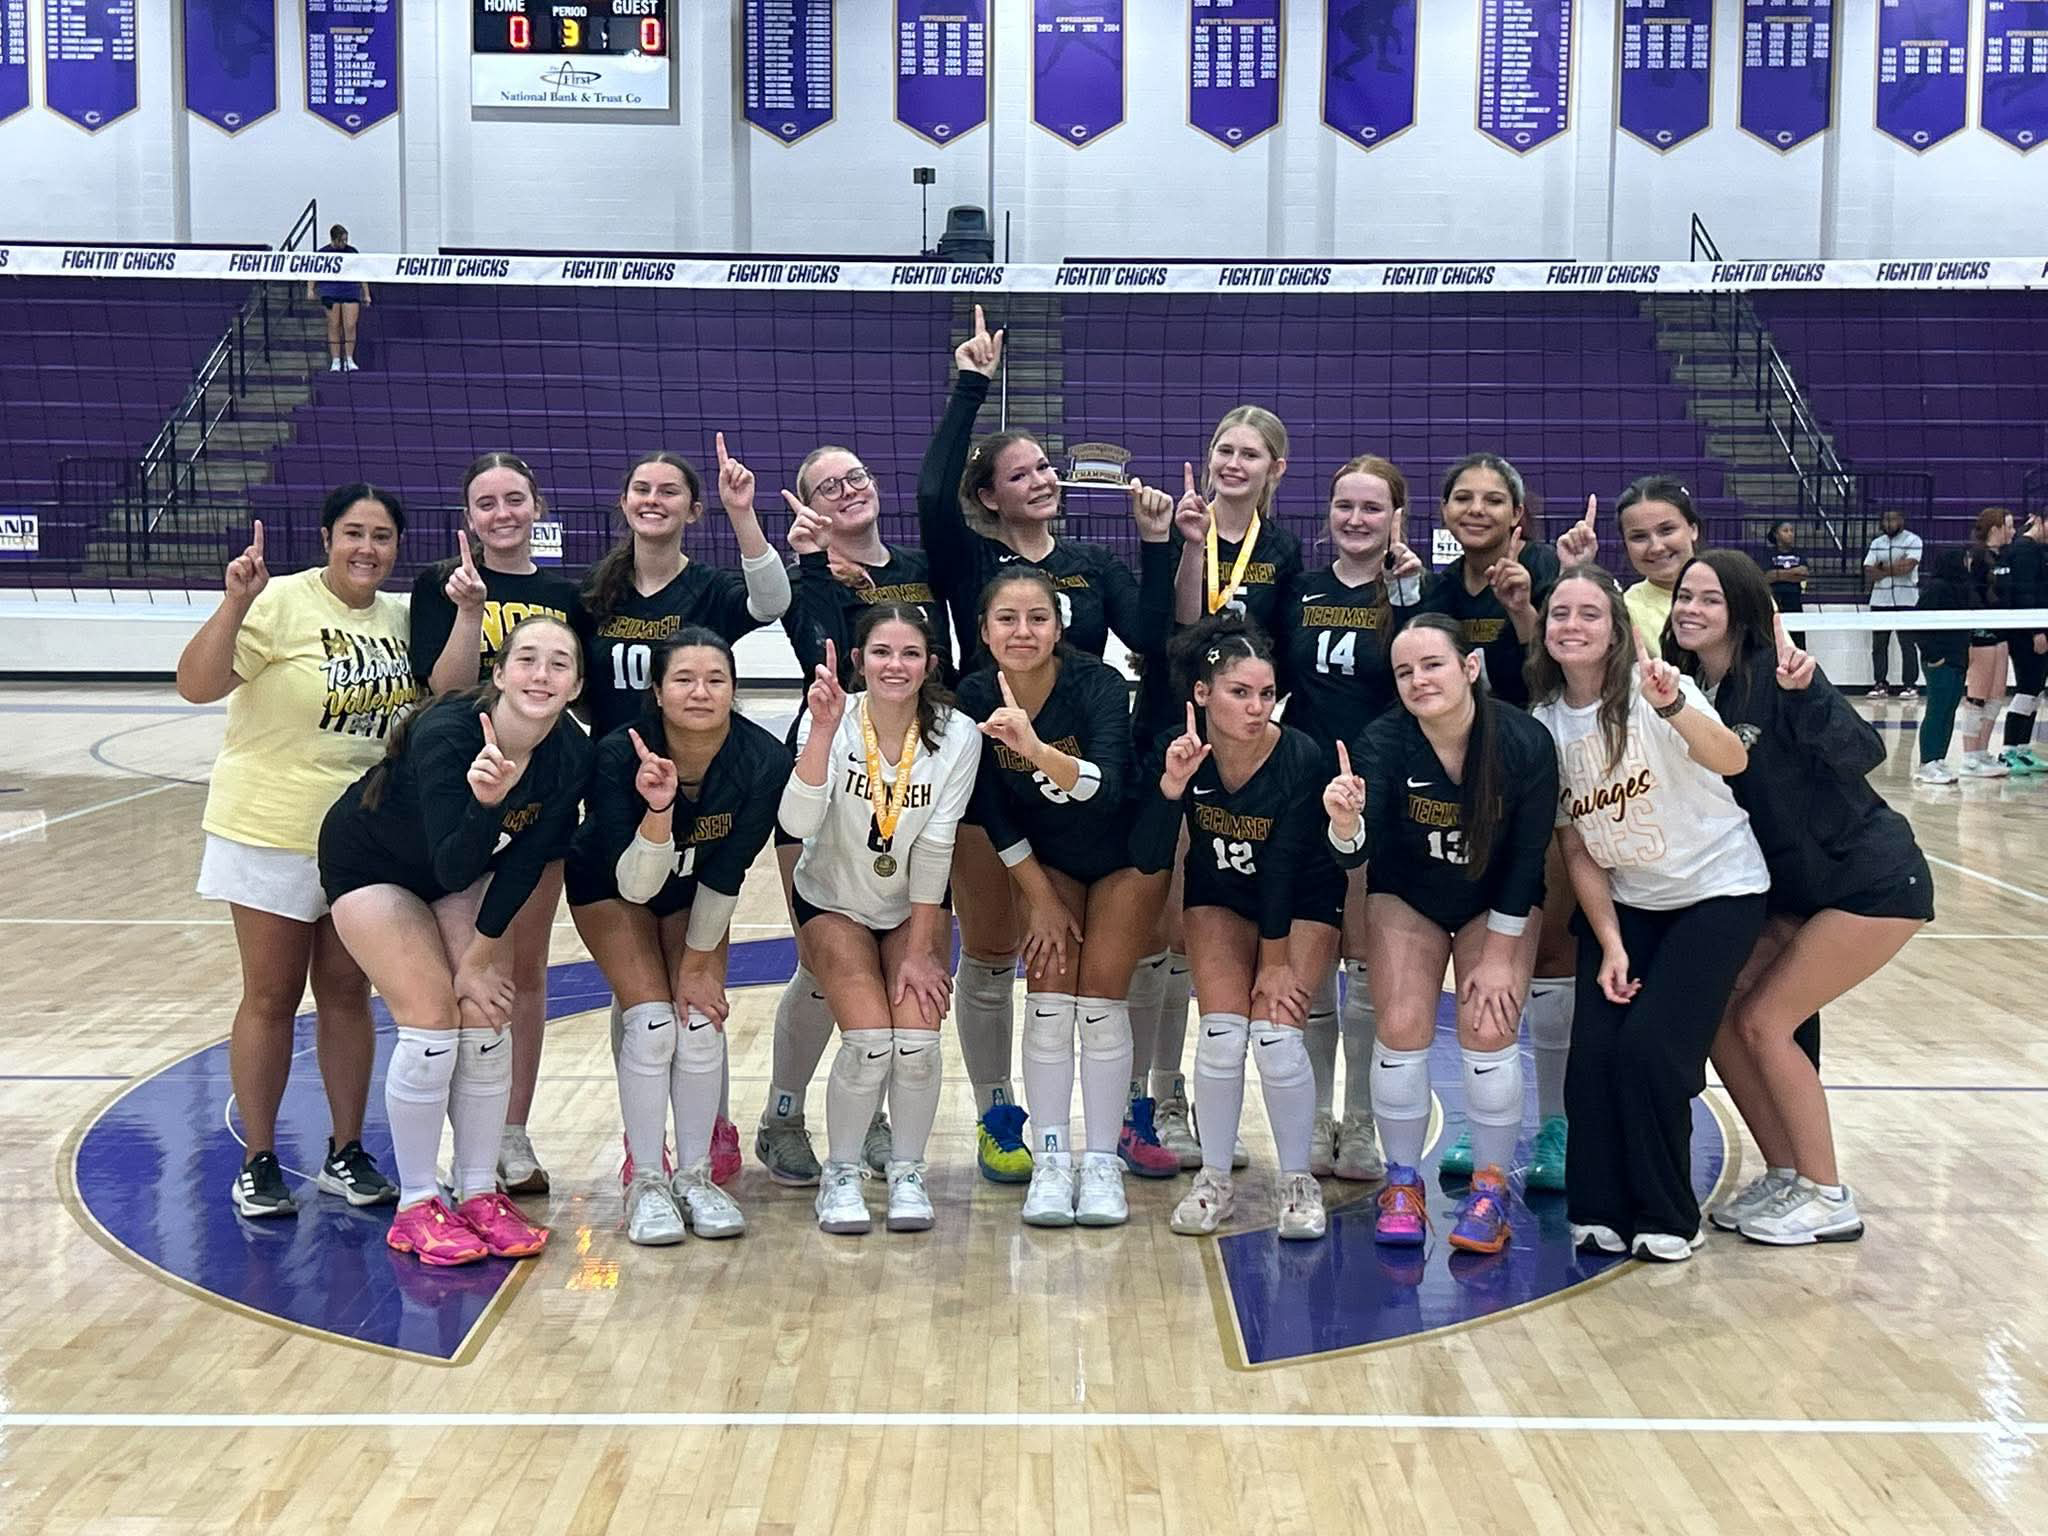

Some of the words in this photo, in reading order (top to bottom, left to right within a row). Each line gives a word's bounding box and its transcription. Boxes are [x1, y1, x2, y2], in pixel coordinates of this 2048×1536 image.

[485, 0, 526, 12] HOME
[613, 0, 658, 14] GUEST
[553, 6, 587, 17] PERIOD
[509, 16, 530, 48] 0
[560, 18, 580, 47] 3
[641, 17, 661, 51] 0
[501, 91, 547, 102] National
[550, 92, 577, 102] Bank
[581, 93, 591, 102] &
[594, 93, 622, 103] Trust
[626, 94, 641, 104] Co
[564, 75, 591, 85] First
[1302, 606, 1378, 629] TECUMSE
[611, 642, 653, 690] 10
[1315, 630, 1357, 676] 14
[1560, 769, 1652, 822] Savages
[1213, 837, 1257, 875] 12
[1427, 830, 1470, 865] 13
